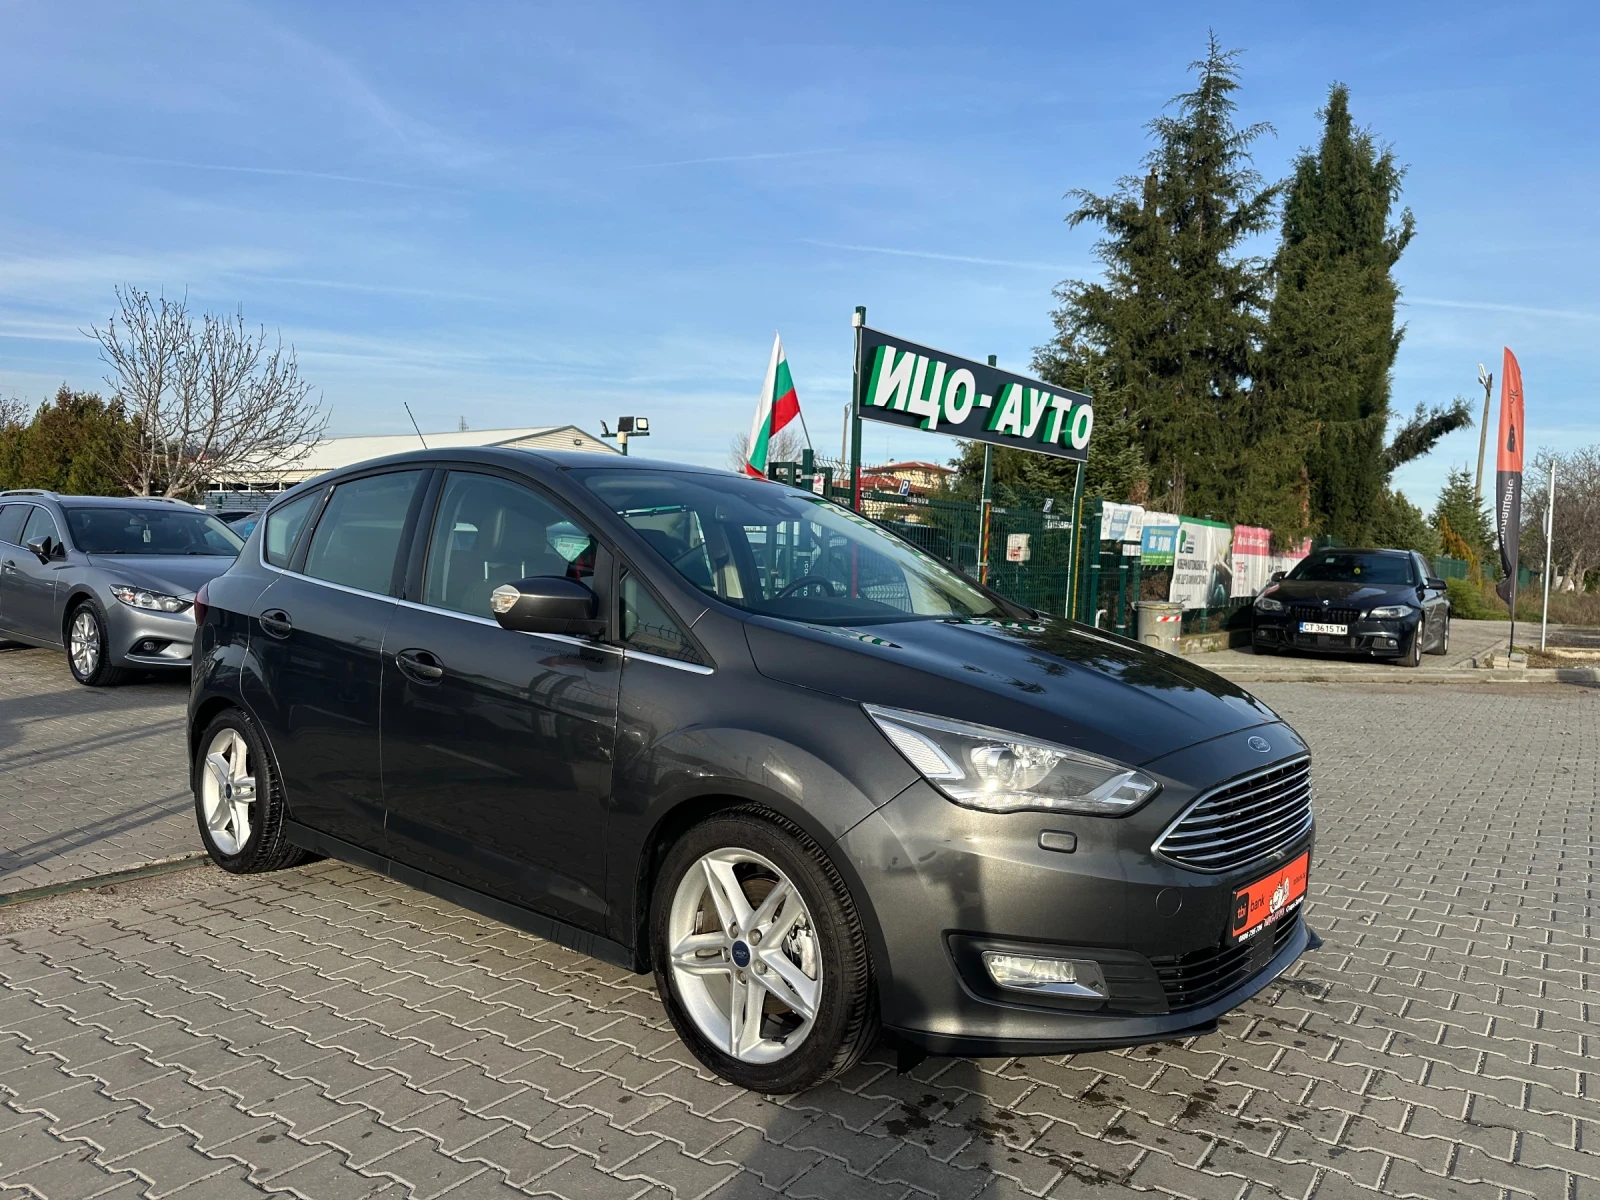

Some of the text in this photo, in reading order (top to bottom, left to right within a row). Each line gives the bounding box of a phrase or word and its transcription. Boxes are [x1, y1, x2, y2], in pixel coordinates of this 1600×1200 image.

[867, 344, 1094, 451] ИЦО-АУТО
[1304, 623, 1346, 634] CT 3615 TM
[1237, 903, 1247, 919] tbi
[1250, 894, 1265, 912] bank
